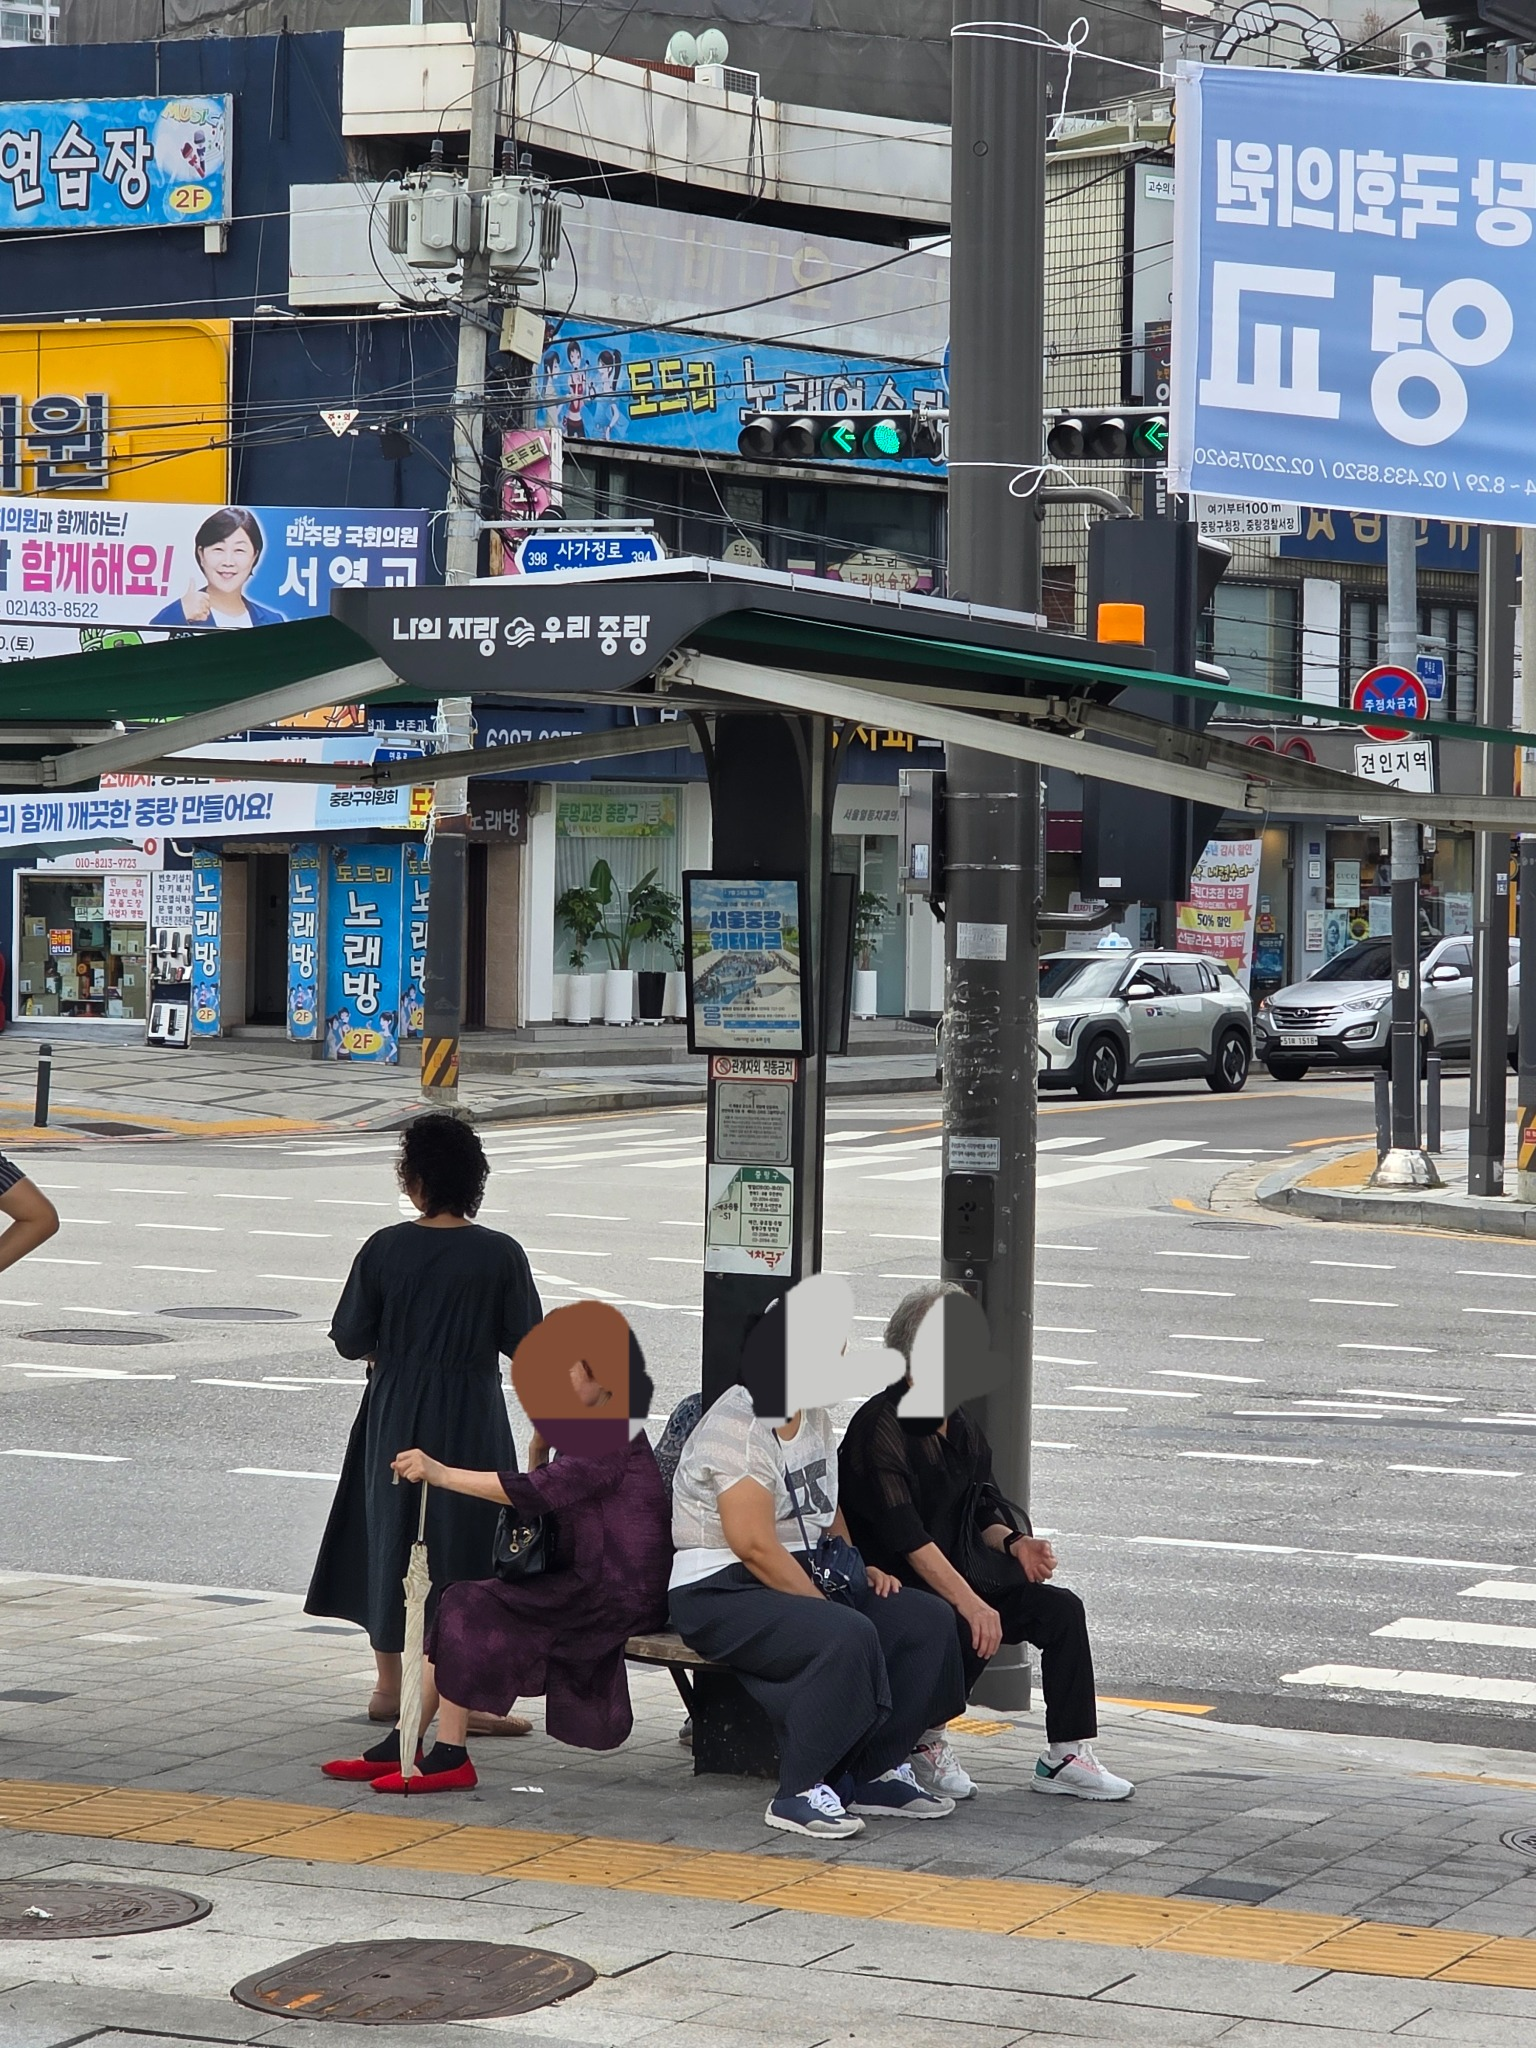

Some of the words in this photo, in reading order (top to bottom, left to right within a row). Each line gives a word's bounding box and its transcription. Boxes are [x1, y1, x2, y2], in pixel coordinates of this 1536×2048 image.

[0, 121, 154, 210] 연습장
[175, 189, 205, 208] 2F
[627, 356, 716, 420] 도드리
[504, 442, 543, 468] 도드리
[57, 509, 129, 537] 함께하는!
[286, 524, 343, 547] 민주당
[345, 525, 419, 549] 국회의원
[527, 551, 548, 567] 398
[557, 540, 624, 561] 사가정로
[21, 539, 175, 597] 함께해요!
[6, 599, 99, 619] 02)433-8522
[393, 617, 441, 641] 나의
[448, 616, 500, 657] 자랑
[541, 616, 591, 643] 우리
[597, 615, 650, 656] 중랑
[1364, 696, 1418, 713] 주정차금지
[1361, 750, 1428, 775] 견인지역
[329, 789, 399, 808] 중랑구위원회
[20, 802, 64, 834] 함께
[67, 798, 131, 831] 깨끗한
[135, 795, 179, 827] 중랑
[181, 792, 274, 825] 만들어요!
[75, 856, 137, 869] 010-8213-9723
[336, 864, 393, 883] 도드리
[408, 860, 431, 875] 도드
[1336, 872, 1359, 880] GUCCI
[195, 873, 218, 977] 노래방
[292, 874, 315, 979] 노래방
[1197, 913, 1215, 928] 50%
[342, 889, 382, 1017] 노래방
[198, 1009, 213, 1020] 2F
[295, 1011, 310, 1023] 2F
[352, 1032, 375, 1050] 2F
[731, 1058, 761, 1074] 관계자외
[763, 1060, 793, 1076] 작동금지
